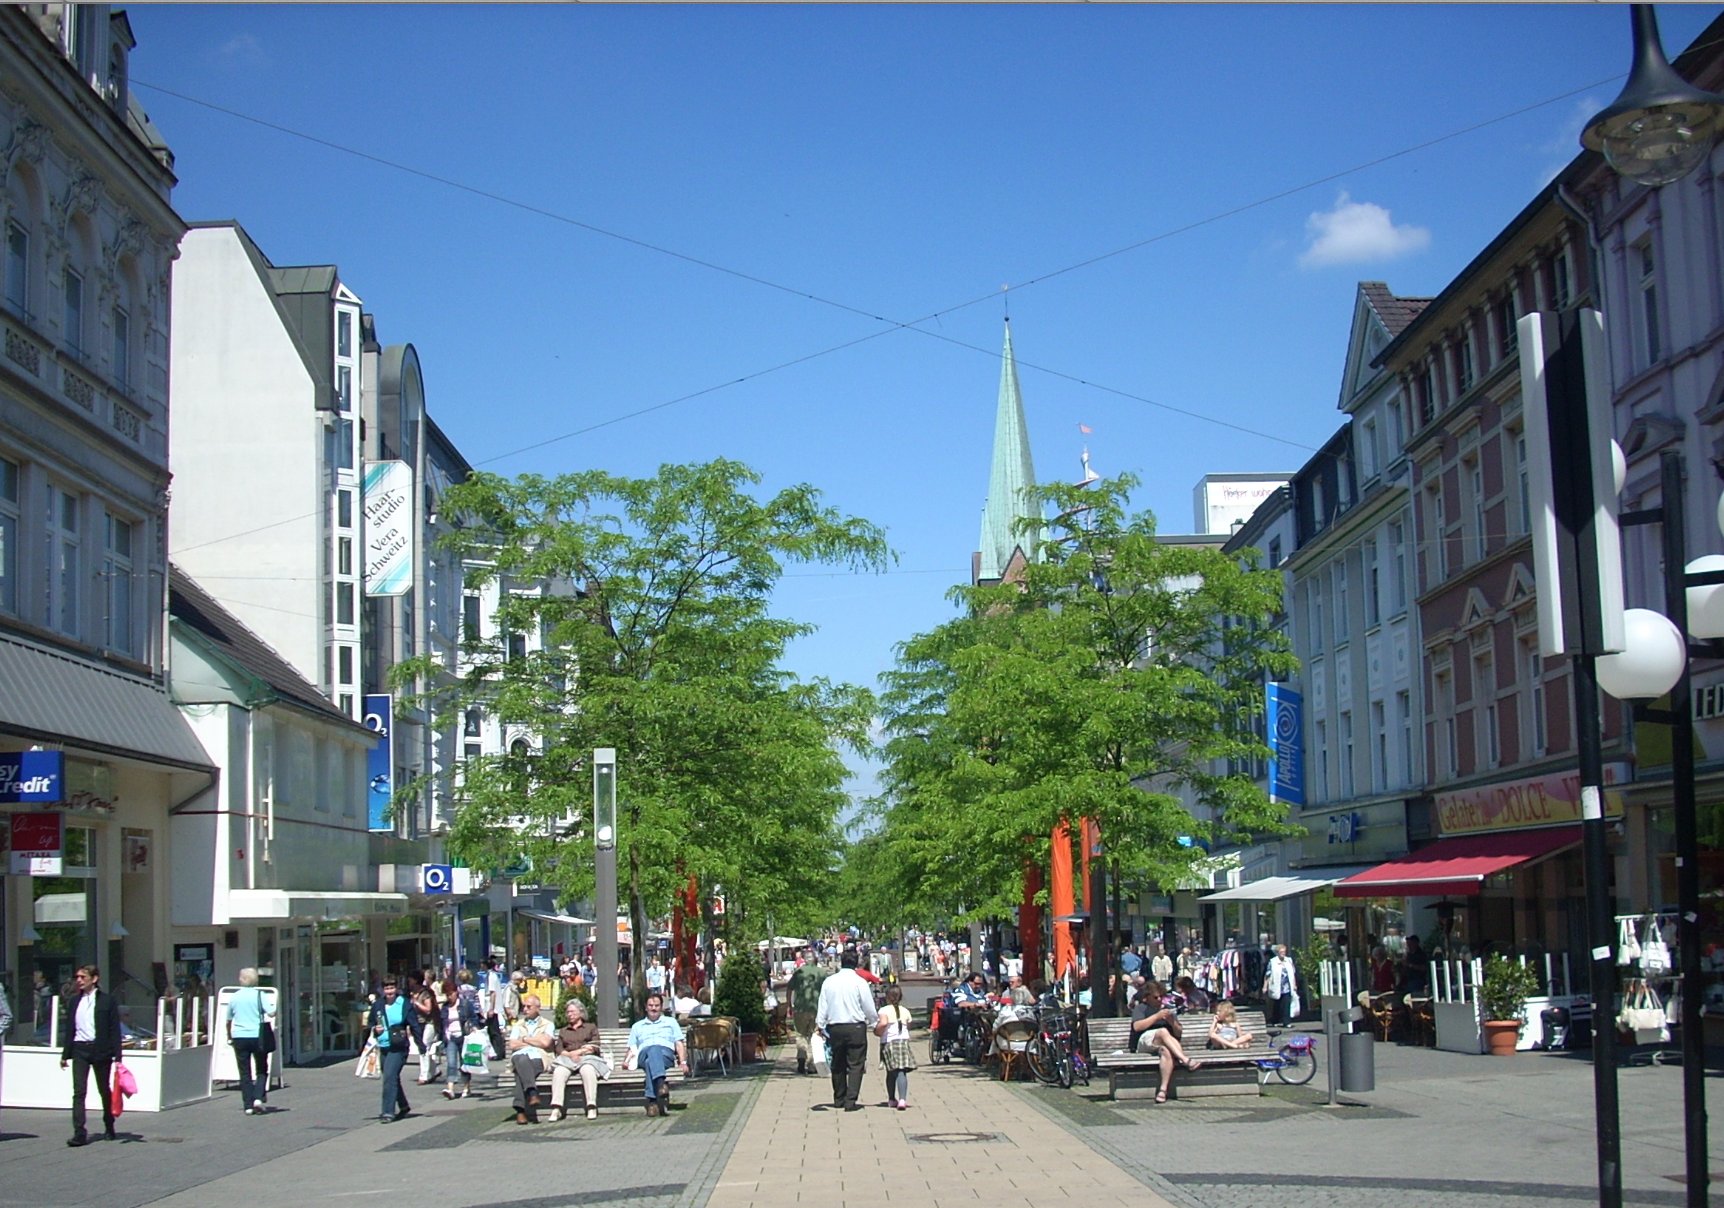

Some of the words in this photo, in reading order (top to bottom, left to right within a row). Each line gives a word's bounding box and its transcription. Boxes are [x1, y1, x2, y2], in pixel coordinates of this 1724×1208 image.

[362, 488, 396, 520] Haar-
[373, 494, 406, 529] studio
[370, 527, 399, 552] Vera
[361, 535, 408, 583] Schweitz
[1277, 745, 1292, 784] APOLLO
[426, 868, 449, 891] O2
